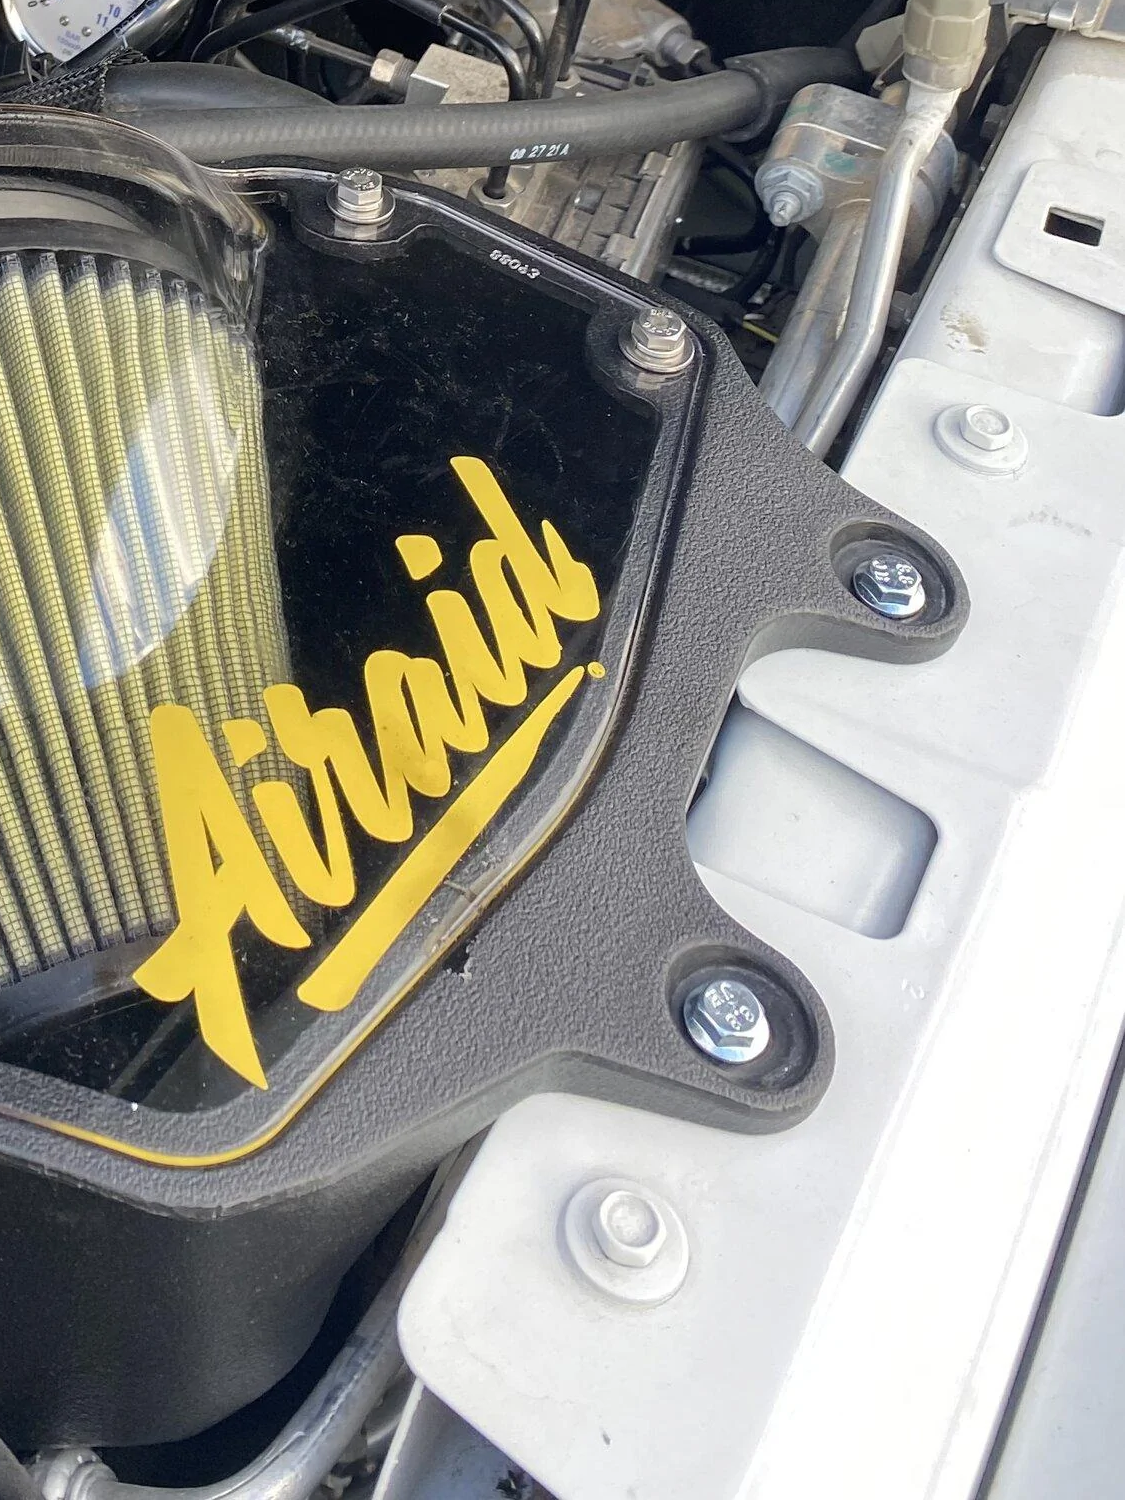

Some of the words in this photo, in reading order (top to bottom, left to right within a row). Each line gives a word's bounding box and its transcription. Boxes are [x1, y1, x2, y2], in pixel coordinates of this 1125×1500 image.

[108, 3, 121, 18] 10
[96, 13, 109, 27] 11
[527, 144, 547, 158] 27
[546, 143, 562, 157] 21
[559, 143, 570, 156] A
[132, 456, 600, 1090] Airaid
